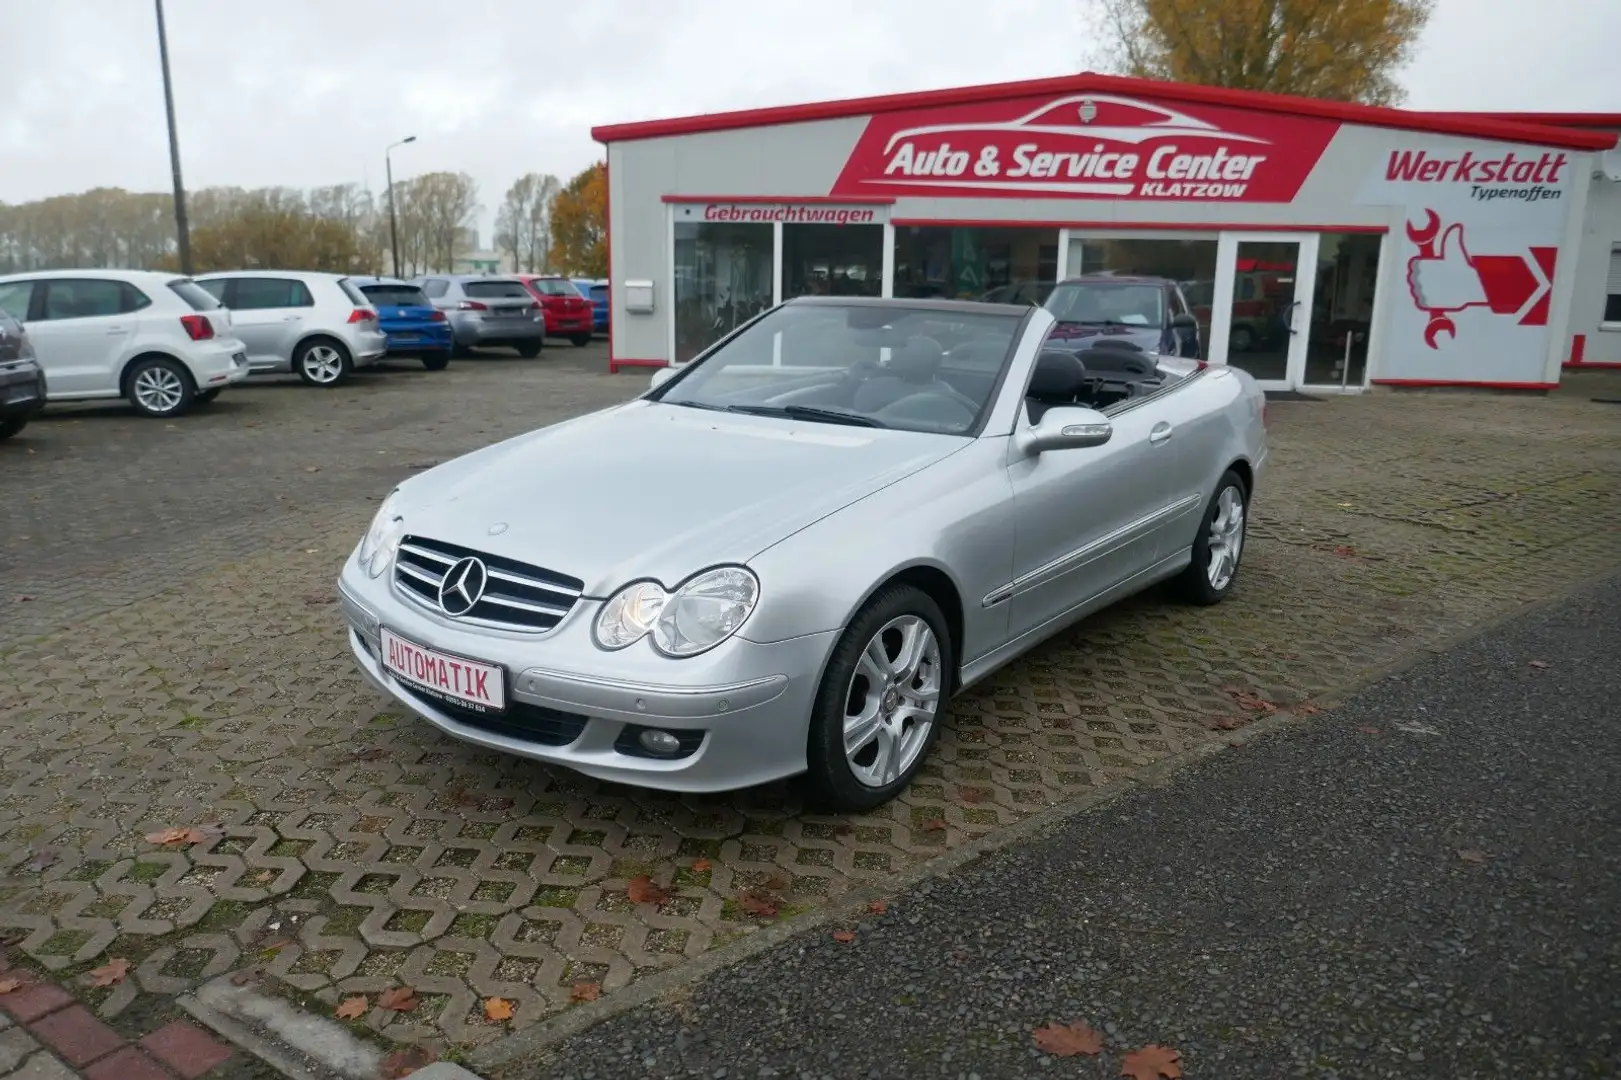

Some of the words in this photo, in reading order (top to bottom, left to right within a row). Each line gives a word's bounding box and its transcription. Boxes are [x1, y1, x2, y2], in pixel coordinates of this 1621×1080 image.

[884, 143, 970, 176] Auto
[973, 144, 1000, 177] &
[1006, 143, 1140, 179] Service
[1145, 145, 1267, 180] Center
[1385, 150, 1568, 184] Werkstatt
[1139, 182, 1249, 198] KLATZOW
[1470, 185, 1562, 201] Typenoffen
[703, 204, 874, 225] Gebrauchtwagen
[389, 637, 490, 701] AUTOMATIK
